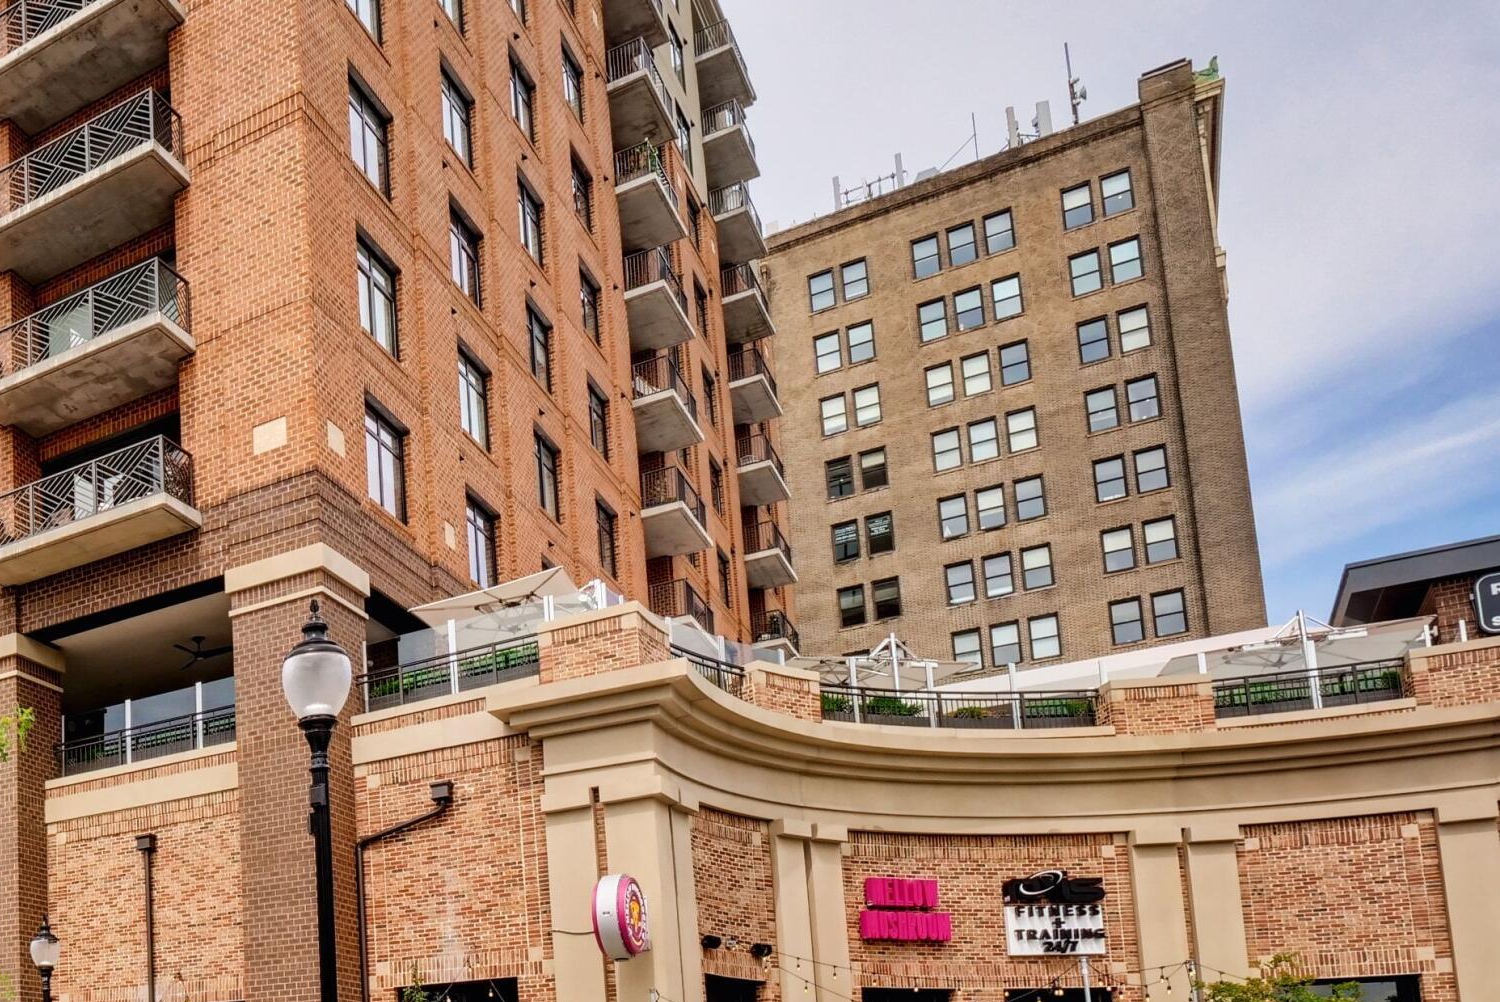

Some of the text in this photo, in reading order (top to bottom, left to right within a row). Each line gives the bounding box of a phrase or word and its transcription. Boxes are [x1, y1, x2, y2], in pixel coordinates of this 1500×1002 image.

[1014, 904, 1101, 917] FITNESS
[1014, 928, 1107, 940] TRAINING
[1042, 940, 1079, 953] 24/7
